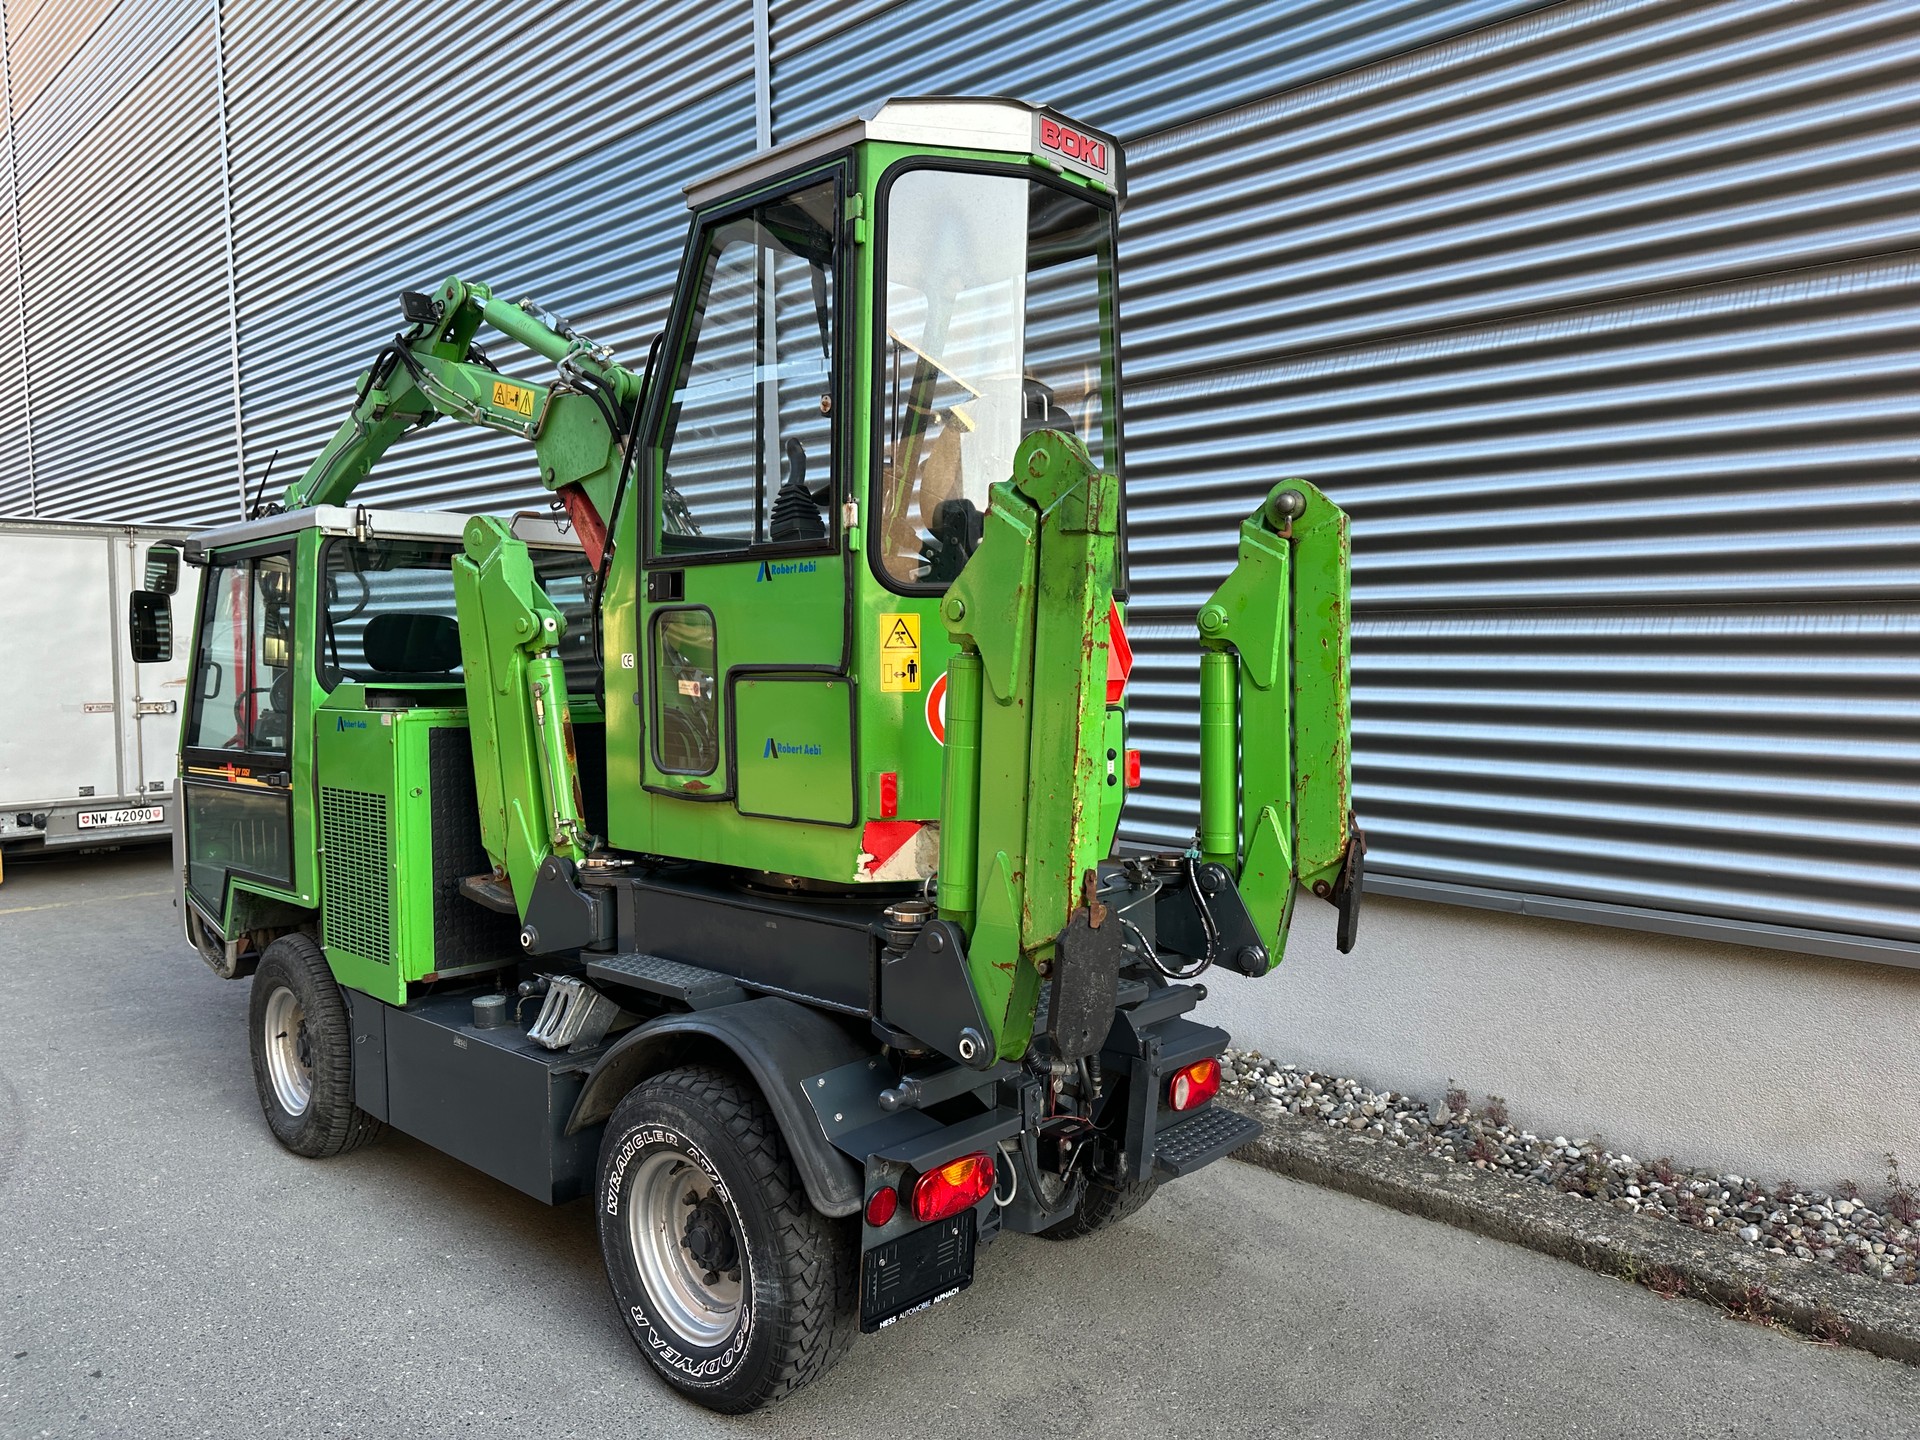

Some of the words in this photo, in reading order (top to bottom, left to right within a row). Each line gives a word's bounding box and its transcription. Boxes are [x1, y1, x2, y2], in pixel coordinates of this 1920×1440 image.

[1041, 117, 1105, 170] BOKI
[771, 563, 797, 575] Robert
[799, 560, 816, 573] Aebi
[622, 654, 633, 668] CE
[777, 742, 802, 755] Robert
[804, 744, 822, 756] Aebi
[91, 813, 108, 825] NW
[115, 809, 151, 822] 42090
[607, 1130, 679, 1216] WRANGLER
[879, 1315, 897, 1329] HESS
[899, 1299, 932, 1320] AUTOMOBILE
[933, 1286, 960, 1304] ALPNACH
[631, 1303, 749, 1378] GOODYEAR
